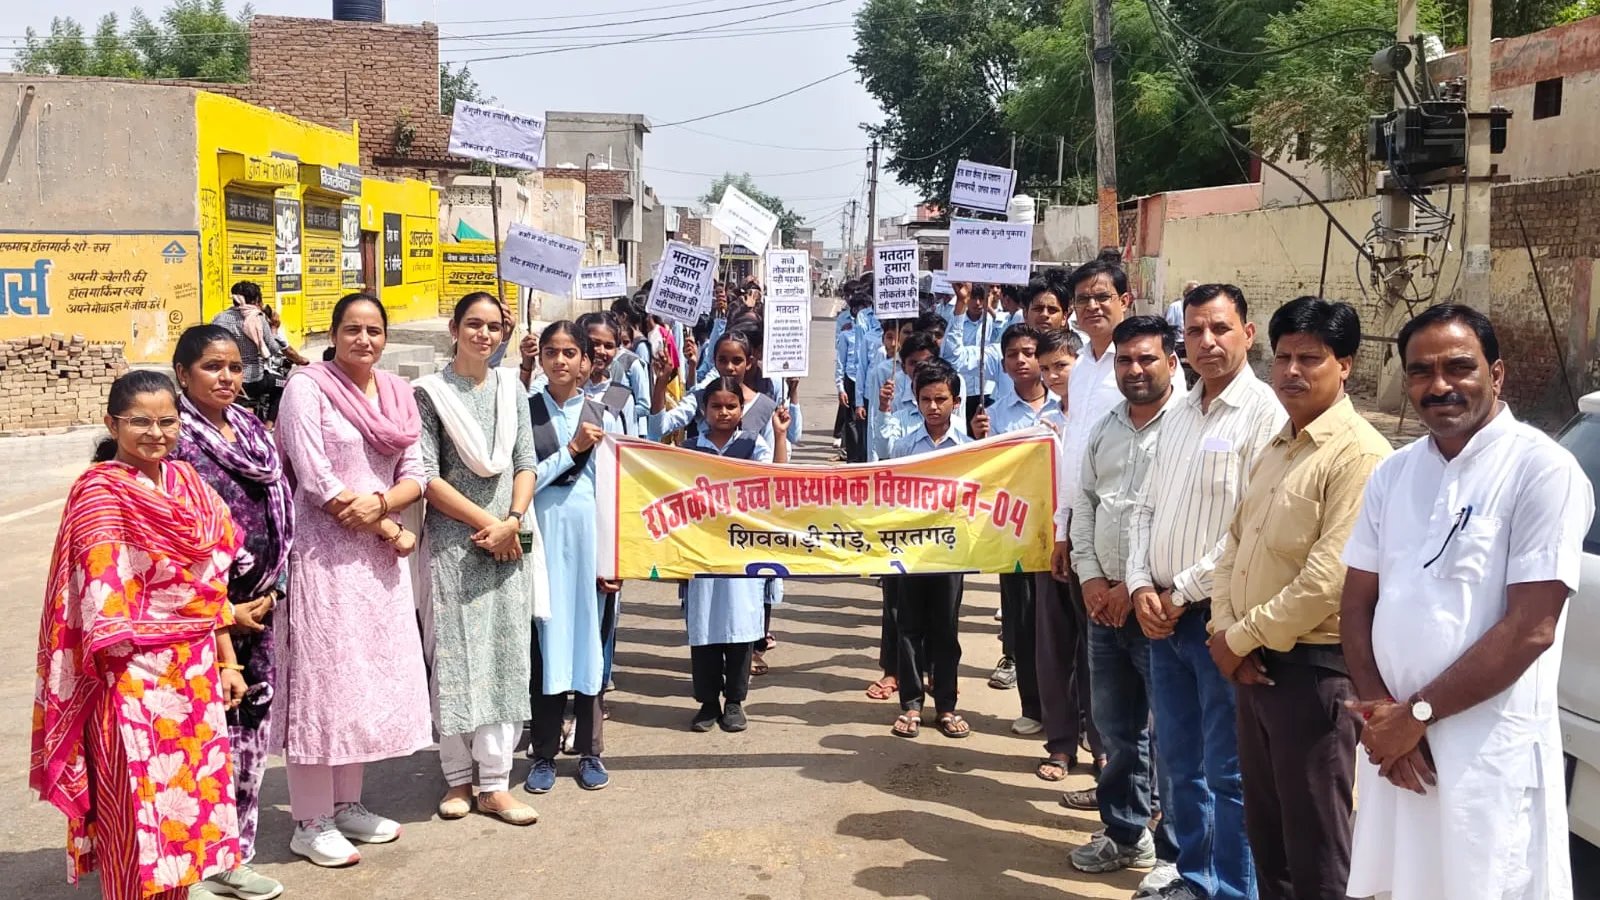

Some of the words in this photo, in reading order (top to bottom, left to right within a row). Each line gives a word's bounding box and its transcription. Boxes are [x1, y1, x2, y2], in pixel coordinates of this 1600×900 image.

[981, 227, 990, 235] की
[672, 250, 709, 271] मतदान
[879, 249, 915, 261] मतदान
[673, 264, 701, 281] हमारा
[884, 262, 911, 274] हमारा
[67, 269, 98, 282] अपनी
[132, 269, 148, 283] की
[879, 274, 908, 286] अधिकार
[662, 276, 694, 292] अधिकार
[660, 288, 687, 304] लोकतंत्र
[688, 297, 698, 307] की
[879, 288, 906, 299] लोकतंत्र
[908, 286, 917, 297] की
[66, 301, 90, 313] अपने
[668, 303, 688, 315] पहचान
[776, 305, 799, 314] मतदान
[641, 476, 731, 539] राजकीय
[733, 477, 770, 512] उच्च
[773, 474, 870, 509] माध्यमिक
[873, 469, 959, 513] विद्यालय
[728, 523, 823, 553] शिवबाड़ी
[877, 526, 956, 553] सूरतगढ़
